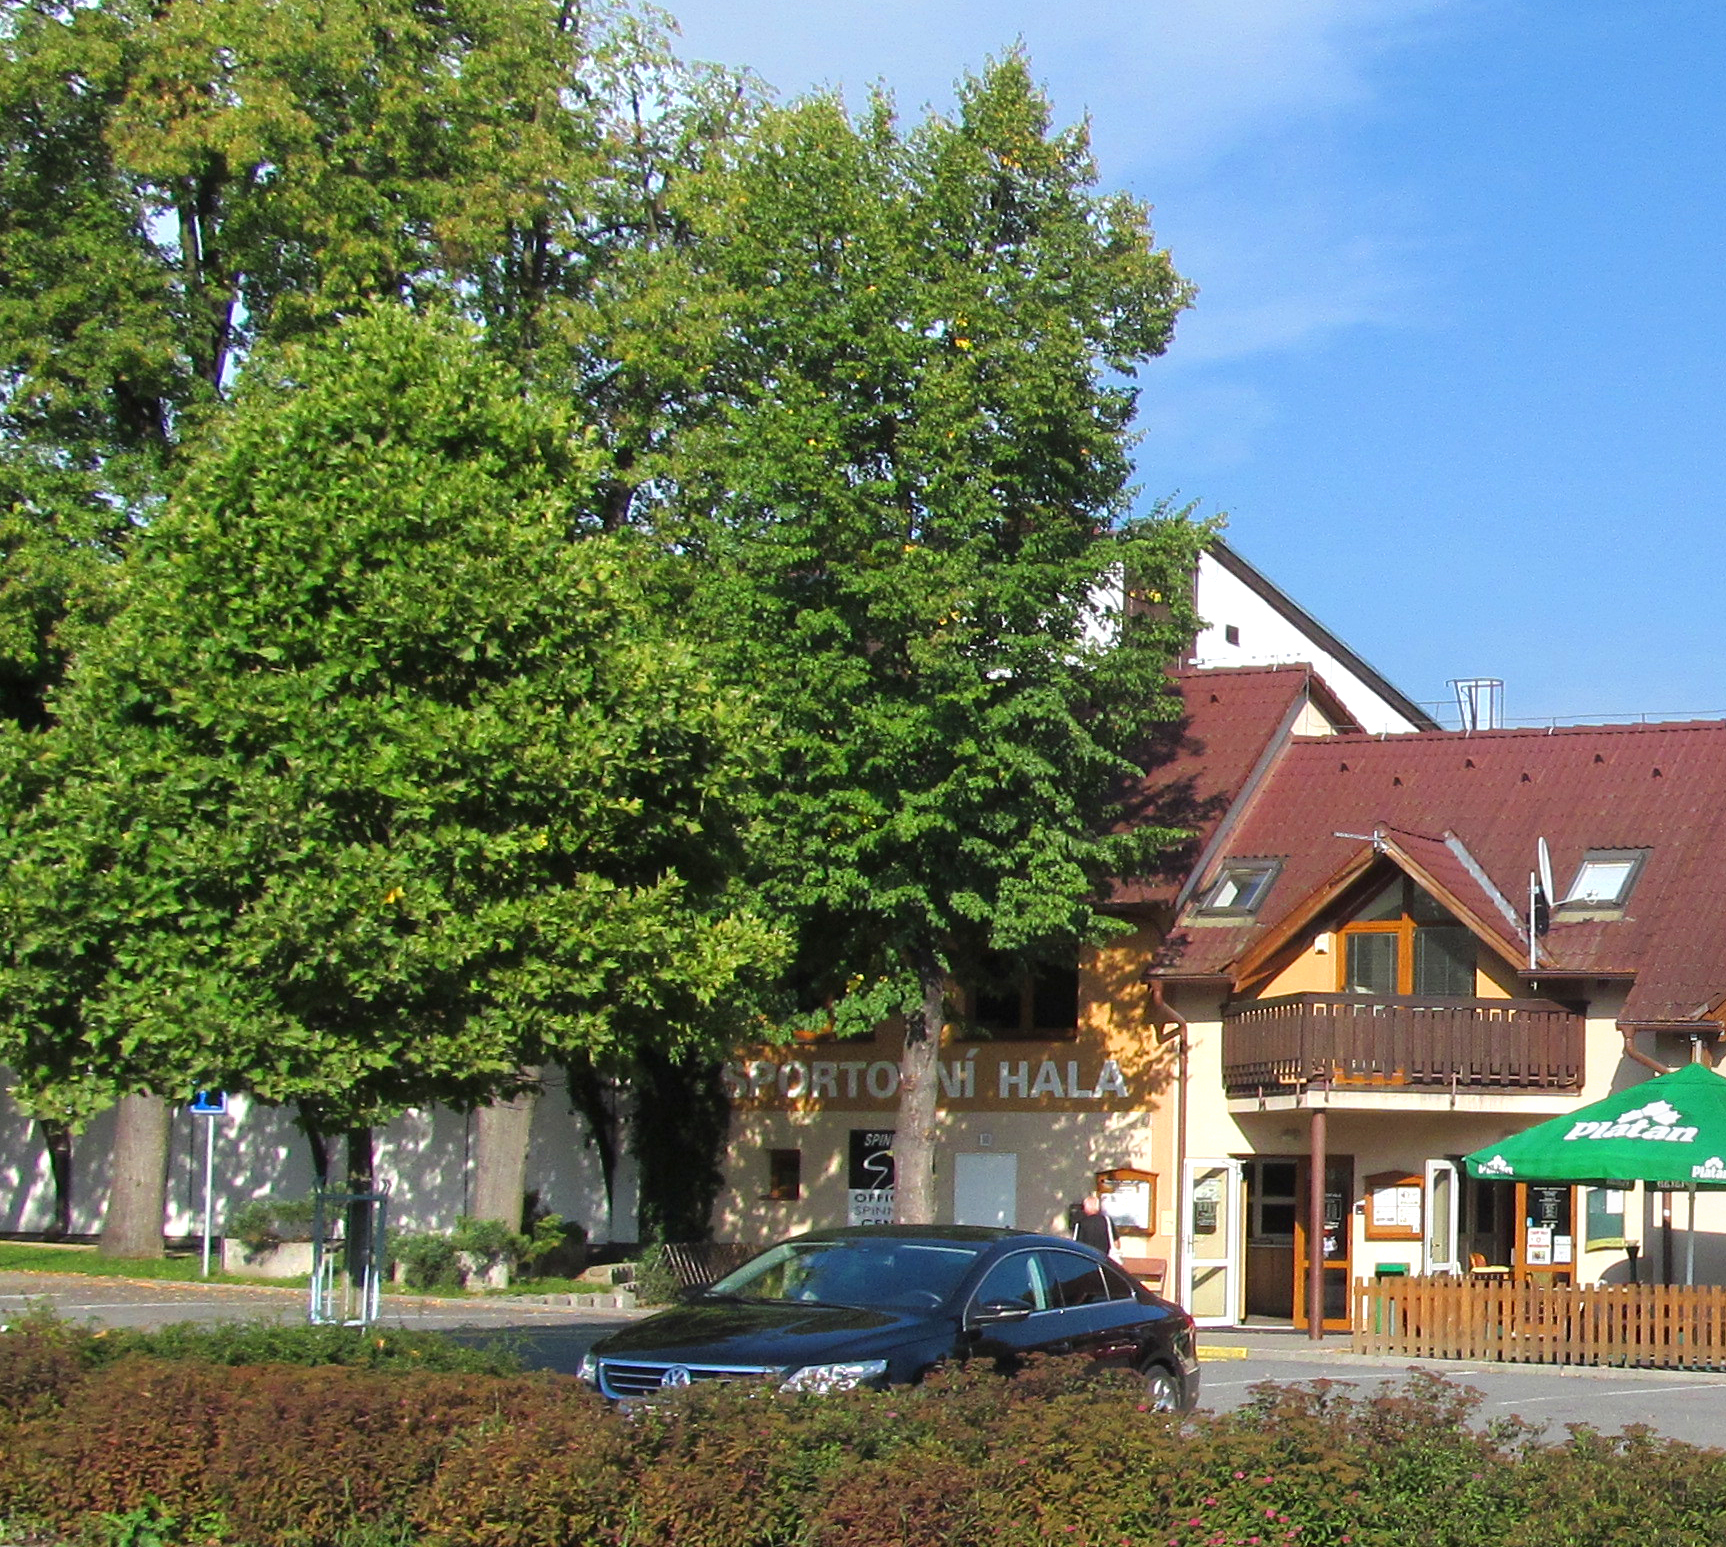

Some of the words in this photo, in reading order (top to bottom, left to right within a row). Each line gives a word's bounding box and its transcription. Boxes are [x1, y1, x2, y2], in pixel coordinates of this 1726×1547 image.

[721, 1047, 979, 1098] SPORTONÍ
[1000, 1061, 1128, 1098] HALA
[1563, 1119, 1698, 1142] Platan
[854, 1193, 894, 1203] OFFI
